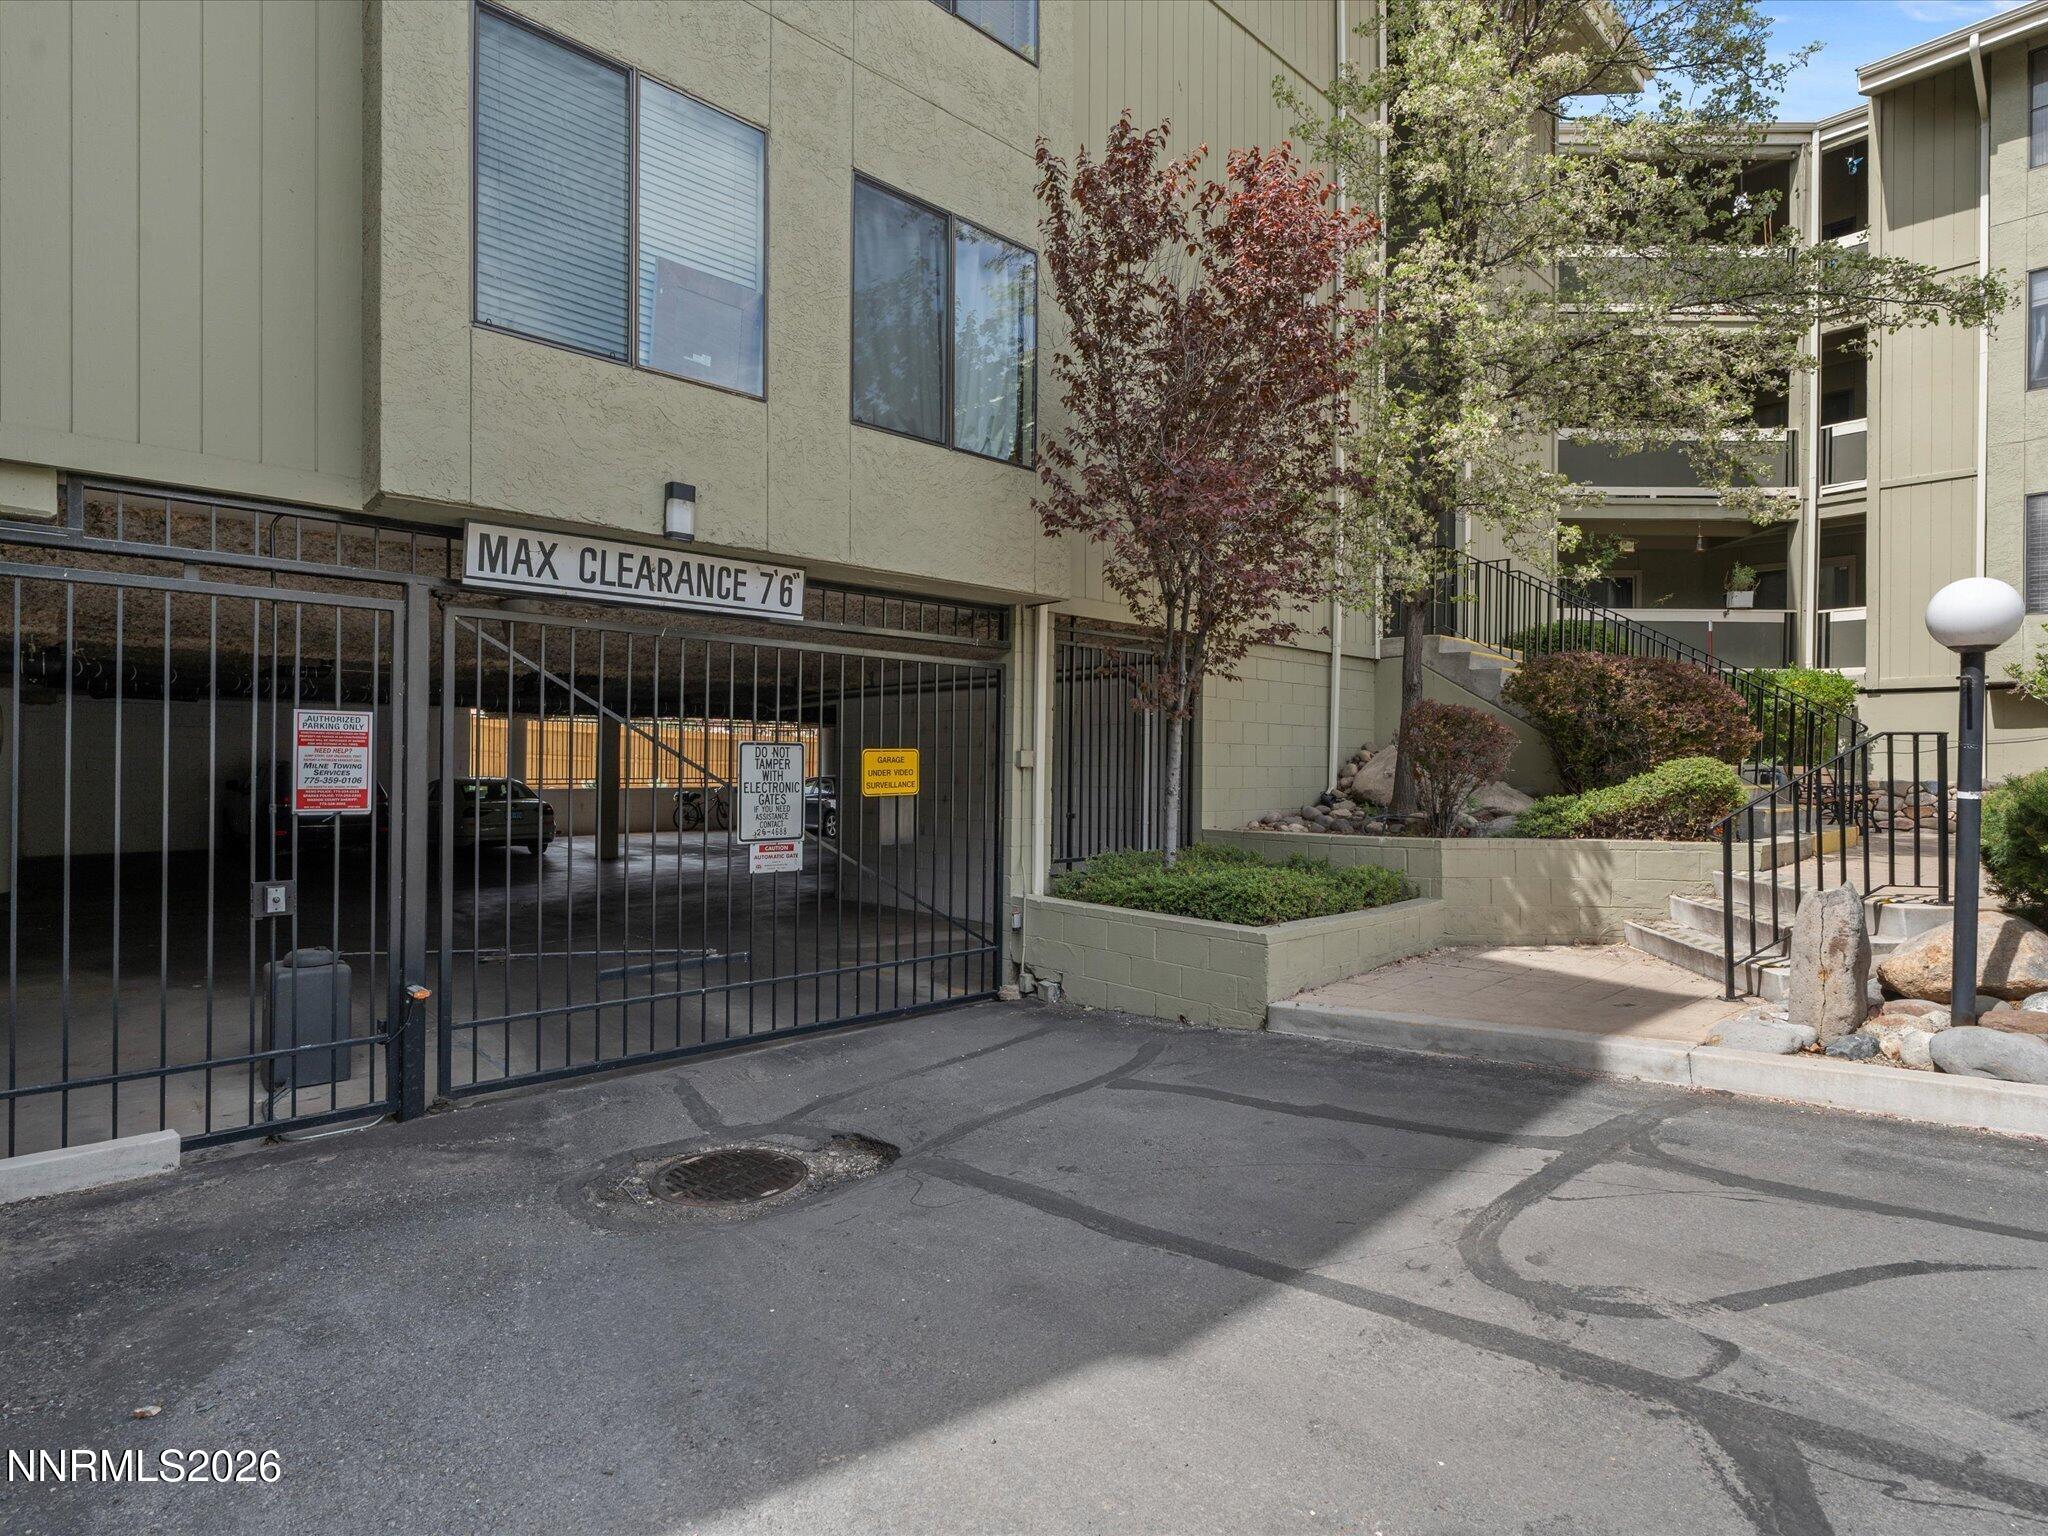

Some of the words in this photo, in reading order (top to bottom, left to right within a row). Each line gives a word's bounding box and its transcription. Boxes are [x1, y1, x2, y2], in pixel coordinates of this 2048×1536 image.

[477, 532, 559, 580] MAX
[578, 546, 748, 602] CLEARANCE
[306, 715, 362, 724] AUTHORIZED
[302, 722, 340, 730] PARKING
[342, 723, 365, 731] ONLY
[755, 746, 768, 758] DO
[772, 747, 791, 758] NOT
[755, 758, 791, 770] TAMPER
[877, 756, 905, 764] GARAGE
[332, 762, 363, 770] TOWING
[762, 770, 784, 781] WITH
[867, 769, 892, 777] UNDER
[893, 768, 914, 776] VIDEO
[743, 781, 800, 793] ELECTRONIC
[866, 781, 916, 789] SURVEILLANCE
[758, 793, 787, 806] GATES
[753, 805, 760, 813] IF
[761, 805, 774, 813] YOU
[775, 804, 791, 812] NEED
[755, 812, 789, 820] ASSISTANCE
[759, 820, 784, 828] CONTACT
